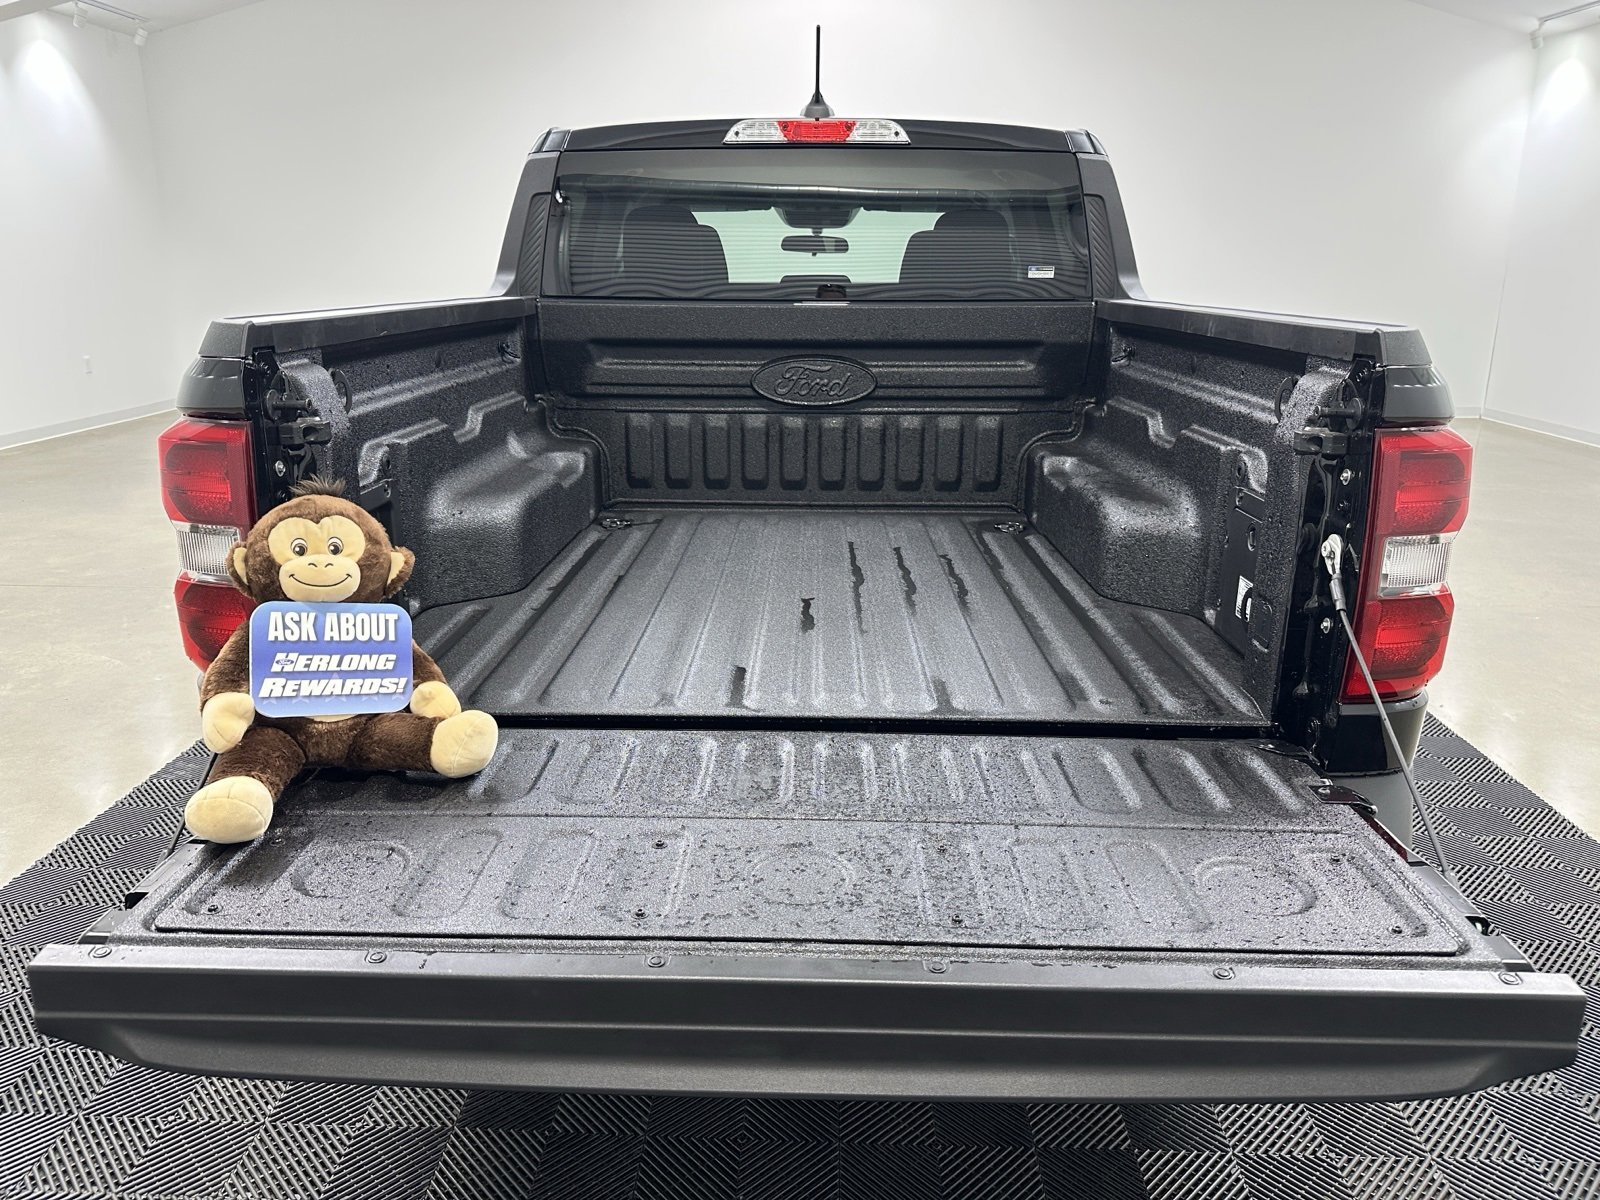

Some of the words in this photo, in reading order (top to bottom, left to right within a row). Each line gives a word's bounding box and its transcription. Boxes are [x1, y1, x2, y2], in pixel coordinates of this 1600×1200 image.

[774, 363, 853, 397] Ford
[268, 611, 317, 641] ASK
[324, 612, 398, 641] ABOUT
[270, 652, 397, 672] HERLONG
[258, 677, 408, 697] REWARDS!
